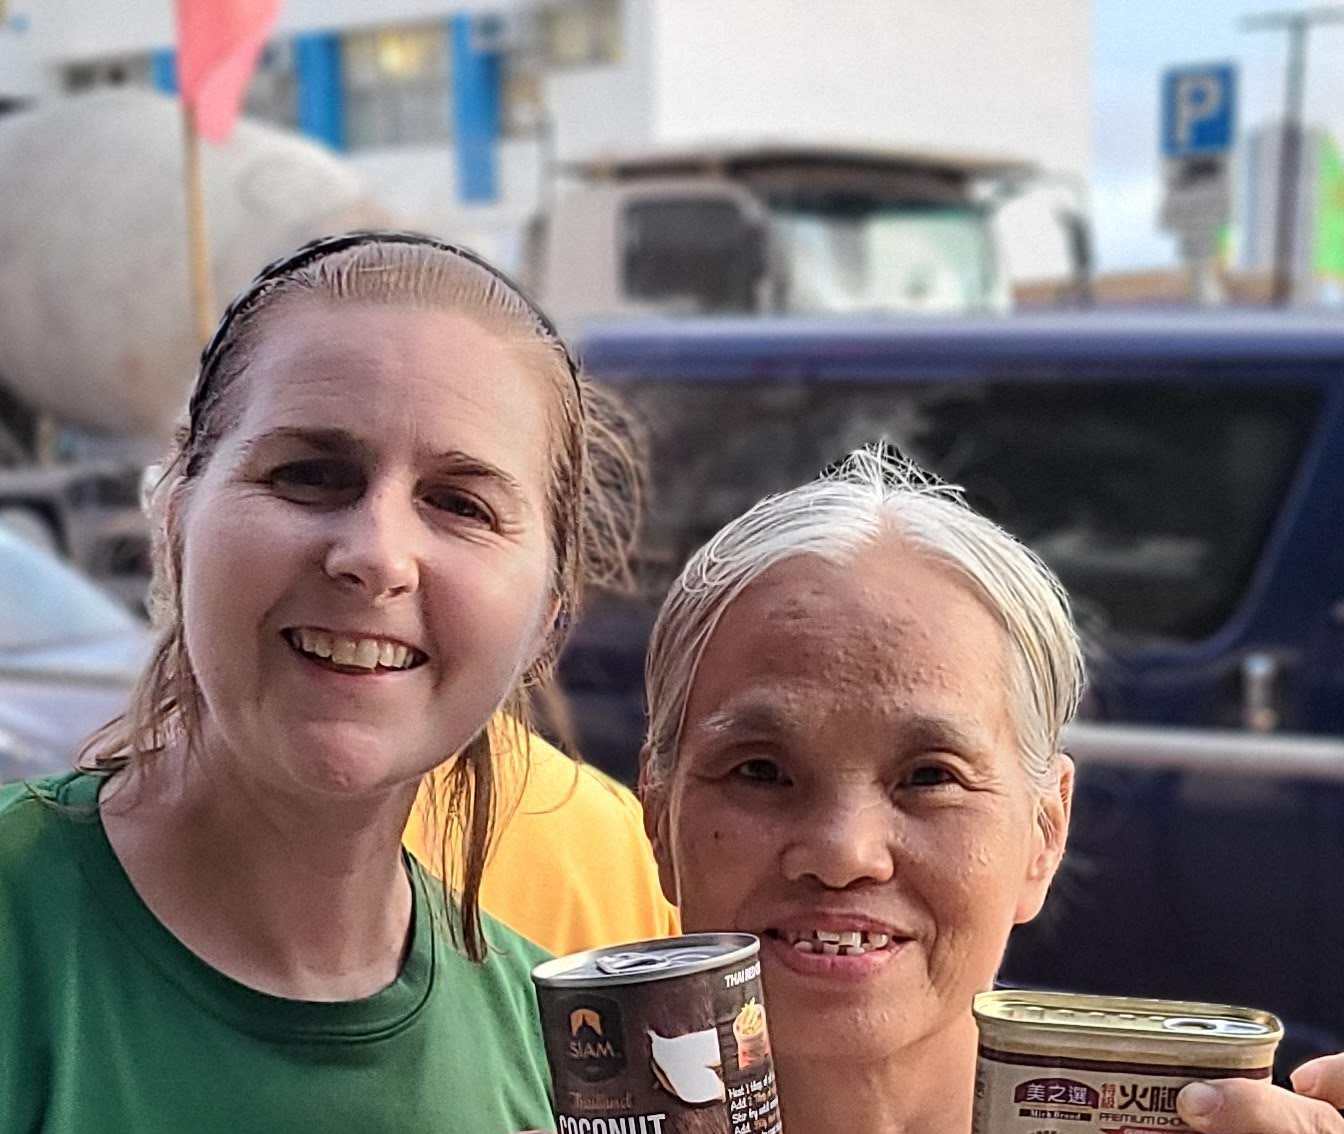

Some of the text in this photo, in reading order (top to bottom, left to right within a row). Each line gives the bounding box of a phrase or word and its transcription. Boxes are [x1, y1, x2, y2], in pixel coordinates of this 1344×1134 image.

[1175, 75, 1222, 147] P
[569, 1040, 616, 1059] SIAM
[1099, 1112, 1155, 1125] PREMIUM
